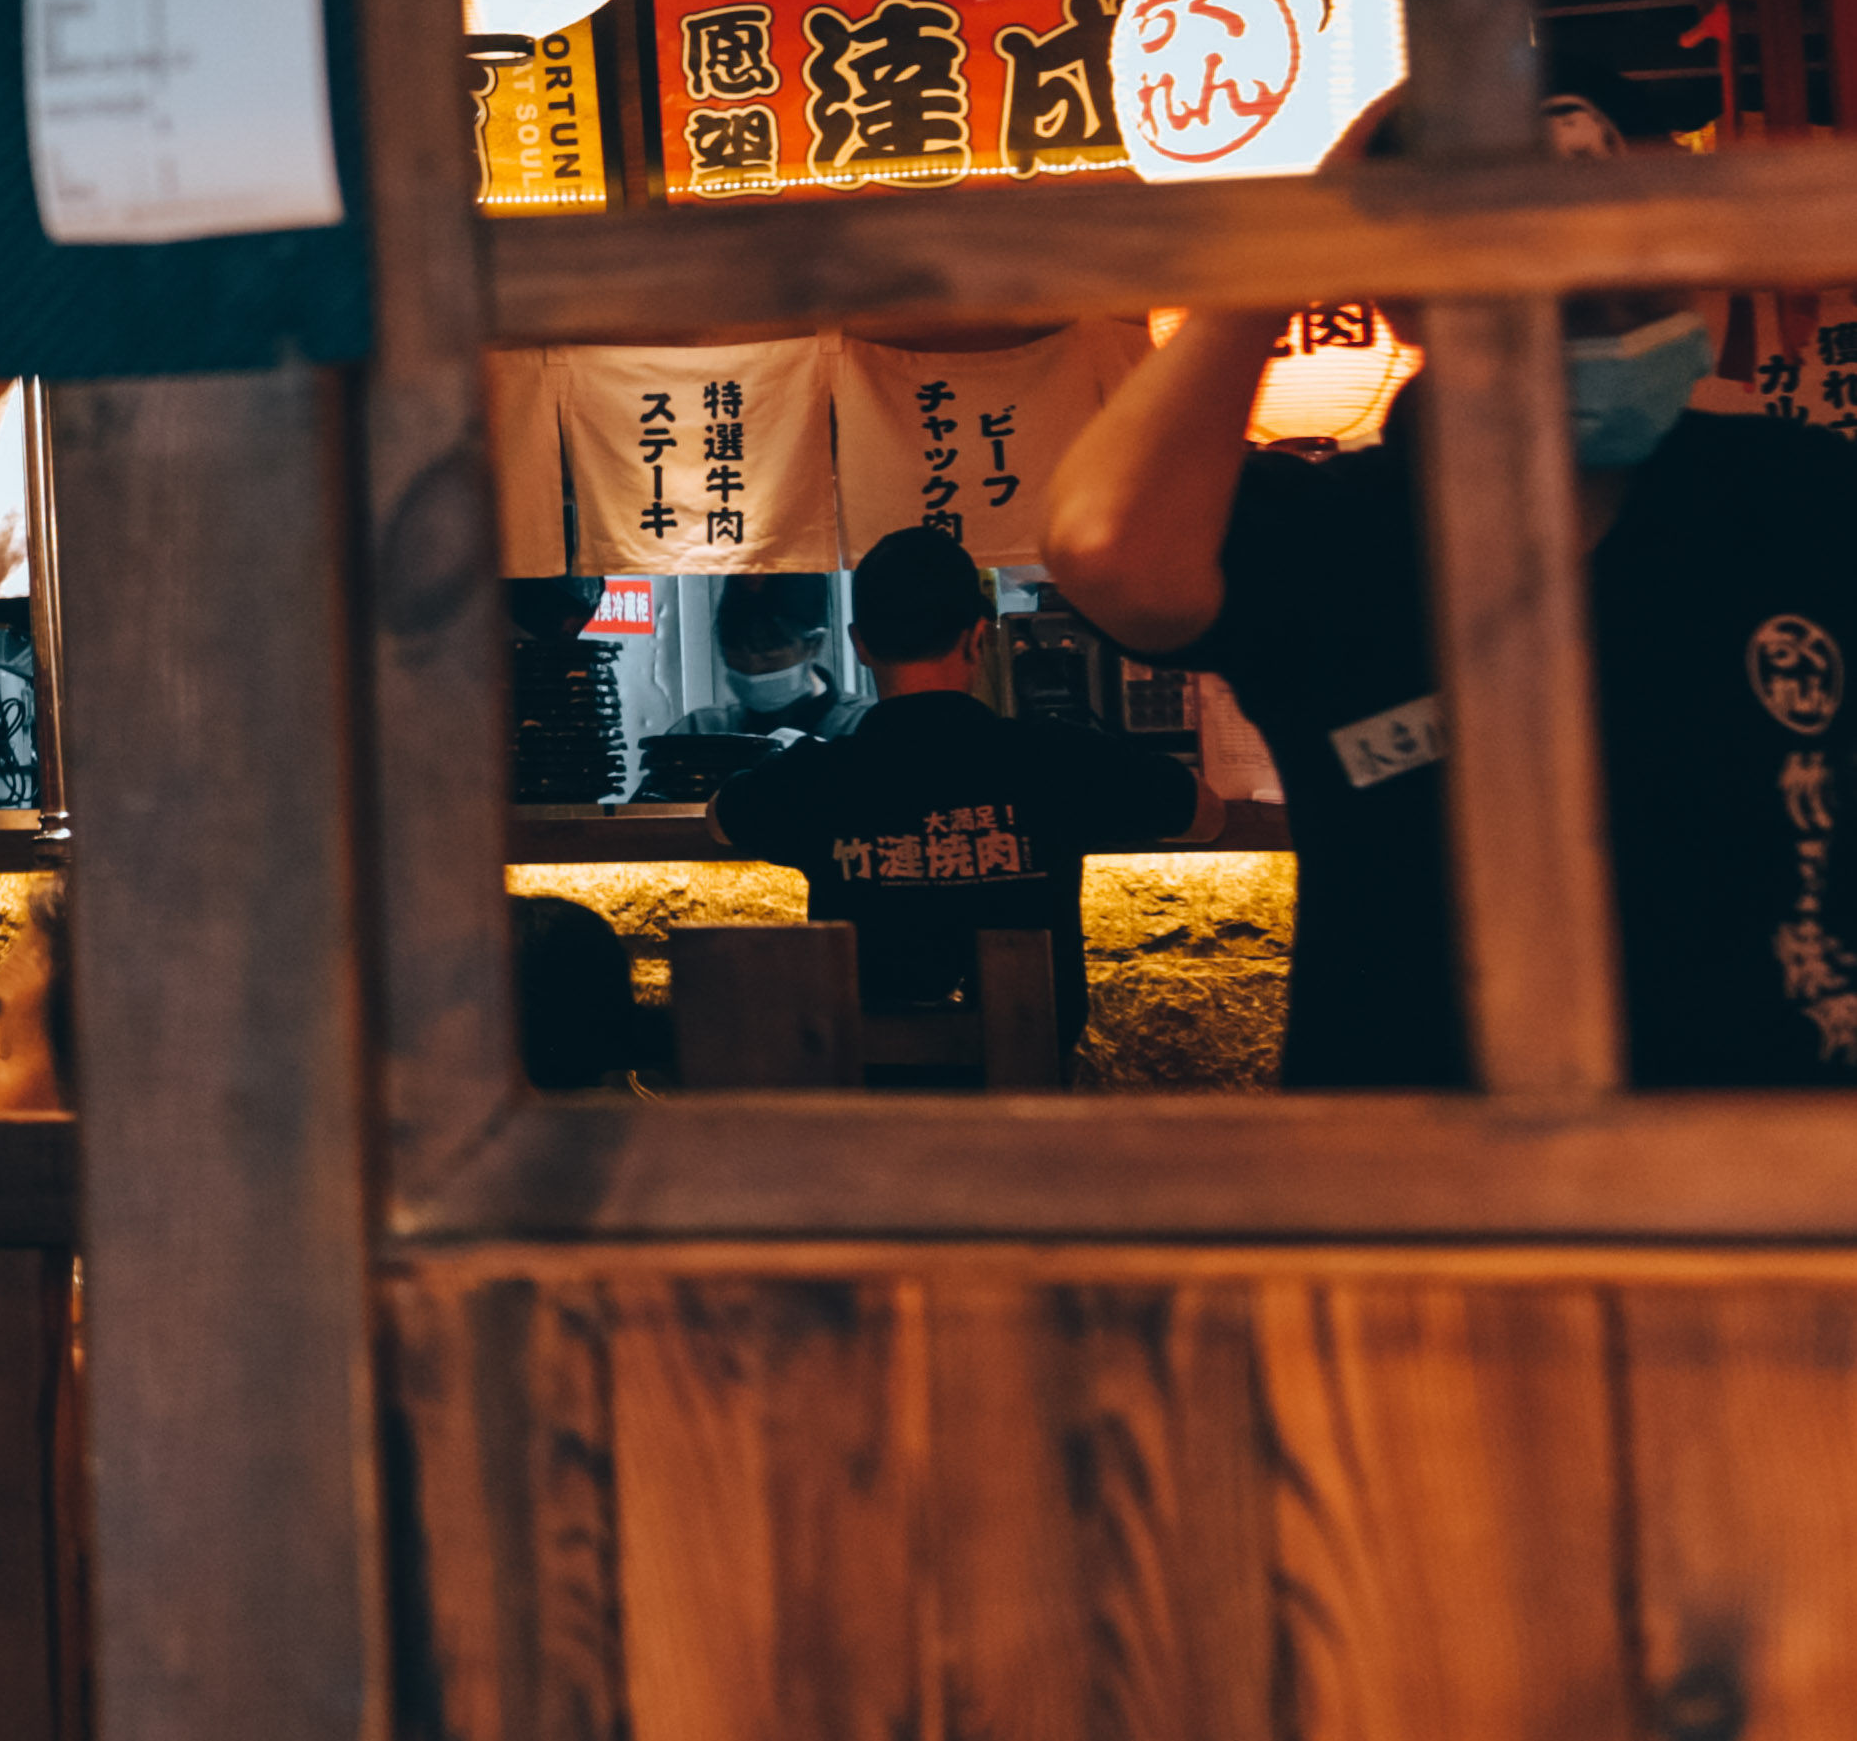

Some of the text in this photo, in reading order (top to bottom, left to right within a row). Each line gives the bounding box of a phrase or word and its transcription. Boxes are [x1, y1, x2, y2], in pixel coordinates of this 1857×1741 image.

[515, 103, 543, 190] SOUL
[638, 392, 678, 540] ステーキ
[704, 380, 745, 545] 特選牛肉
[979, 404, 1021, 508] ビーフ
